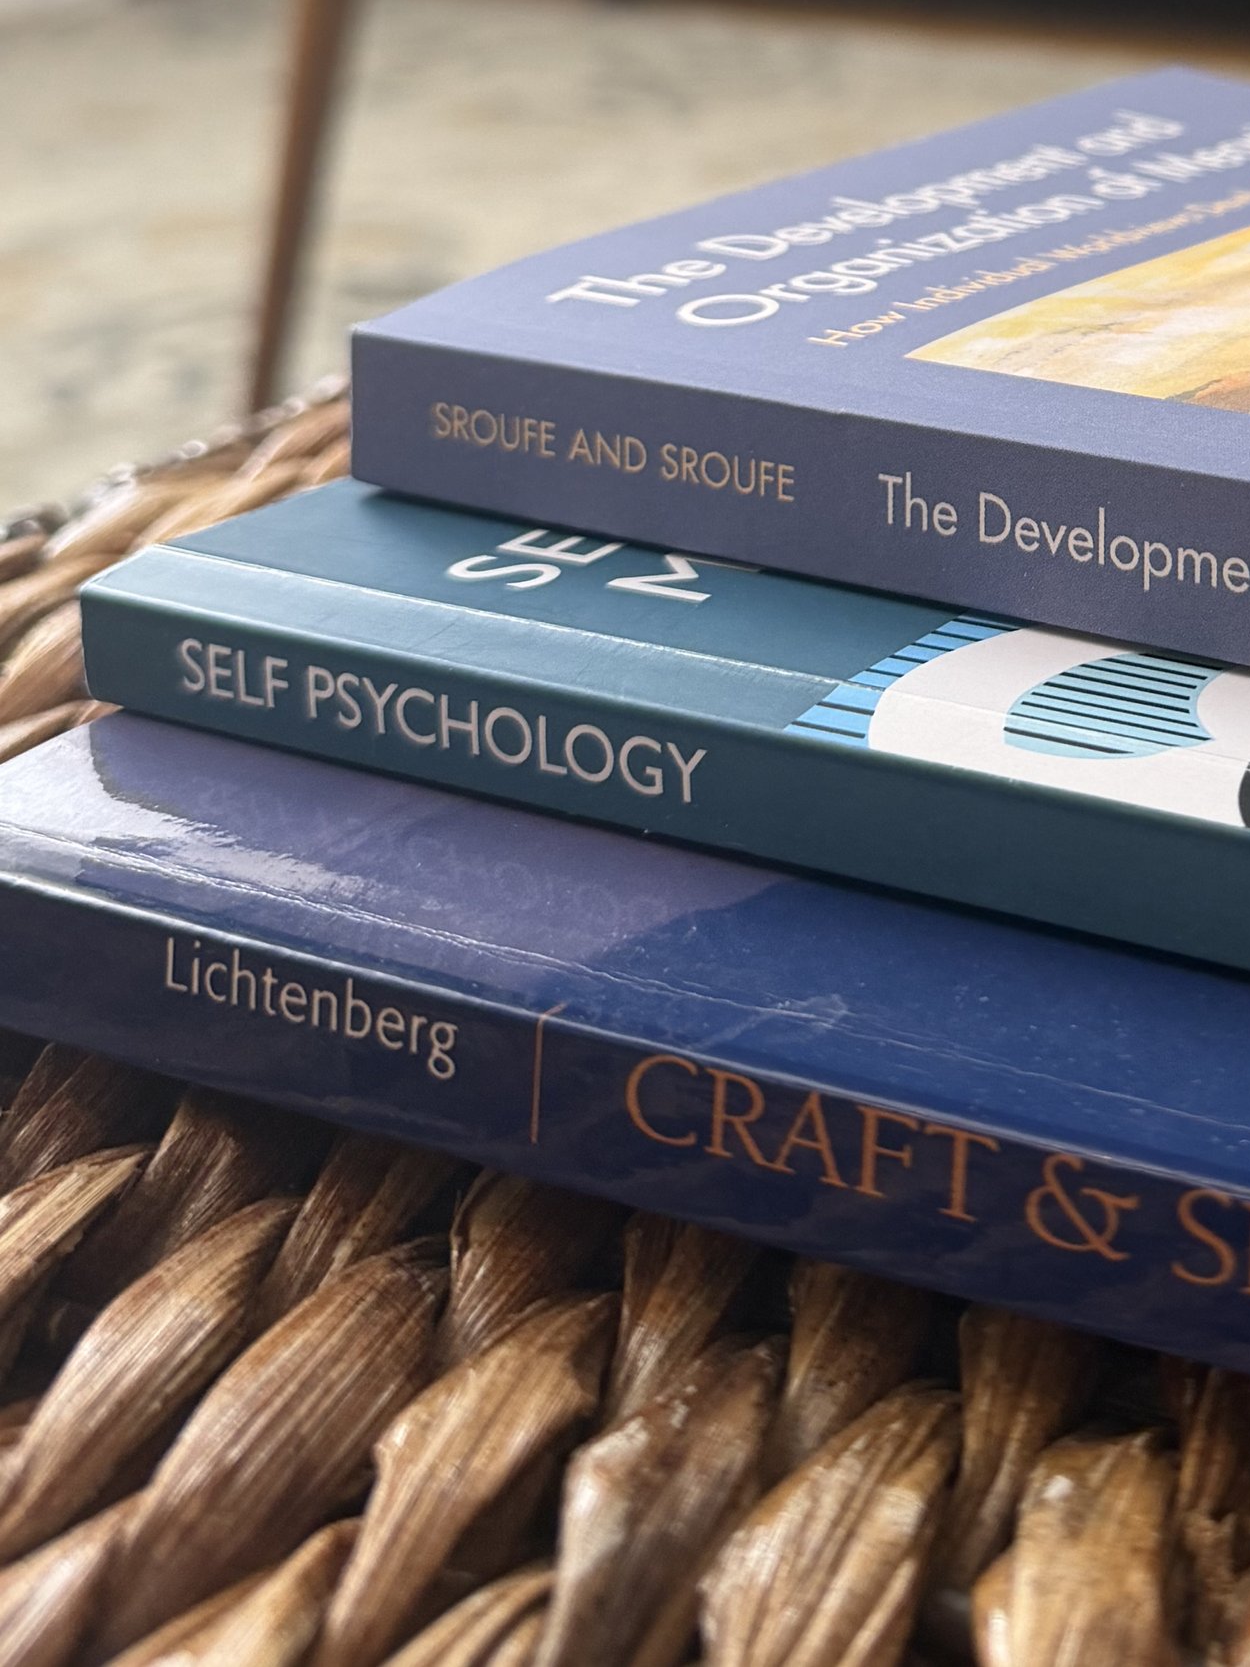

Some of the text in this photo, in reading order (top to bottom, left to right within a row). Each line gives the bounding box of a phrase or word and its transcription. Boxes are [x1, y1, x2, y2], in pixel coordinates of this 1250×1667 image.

[546, 260, 726, 307] The
[694, 143, 1088, 260] Development
[675, 194, 1105, 326] Organization
[1087, 166, 1163, 201] of
[807, 256, 1058, 347] How Individual
[430, 401, 796, 503] SROUFE AND SROUFE
[878, 470, 958, 537] The
[179, 637, 708, 804] SELF PSYCHOLOGY
[164, 936, 459, 1081] Lichtenberg
[623, 1052, 999, 1223] CRAFT
[1022, 1151, 1140, 1261] &
